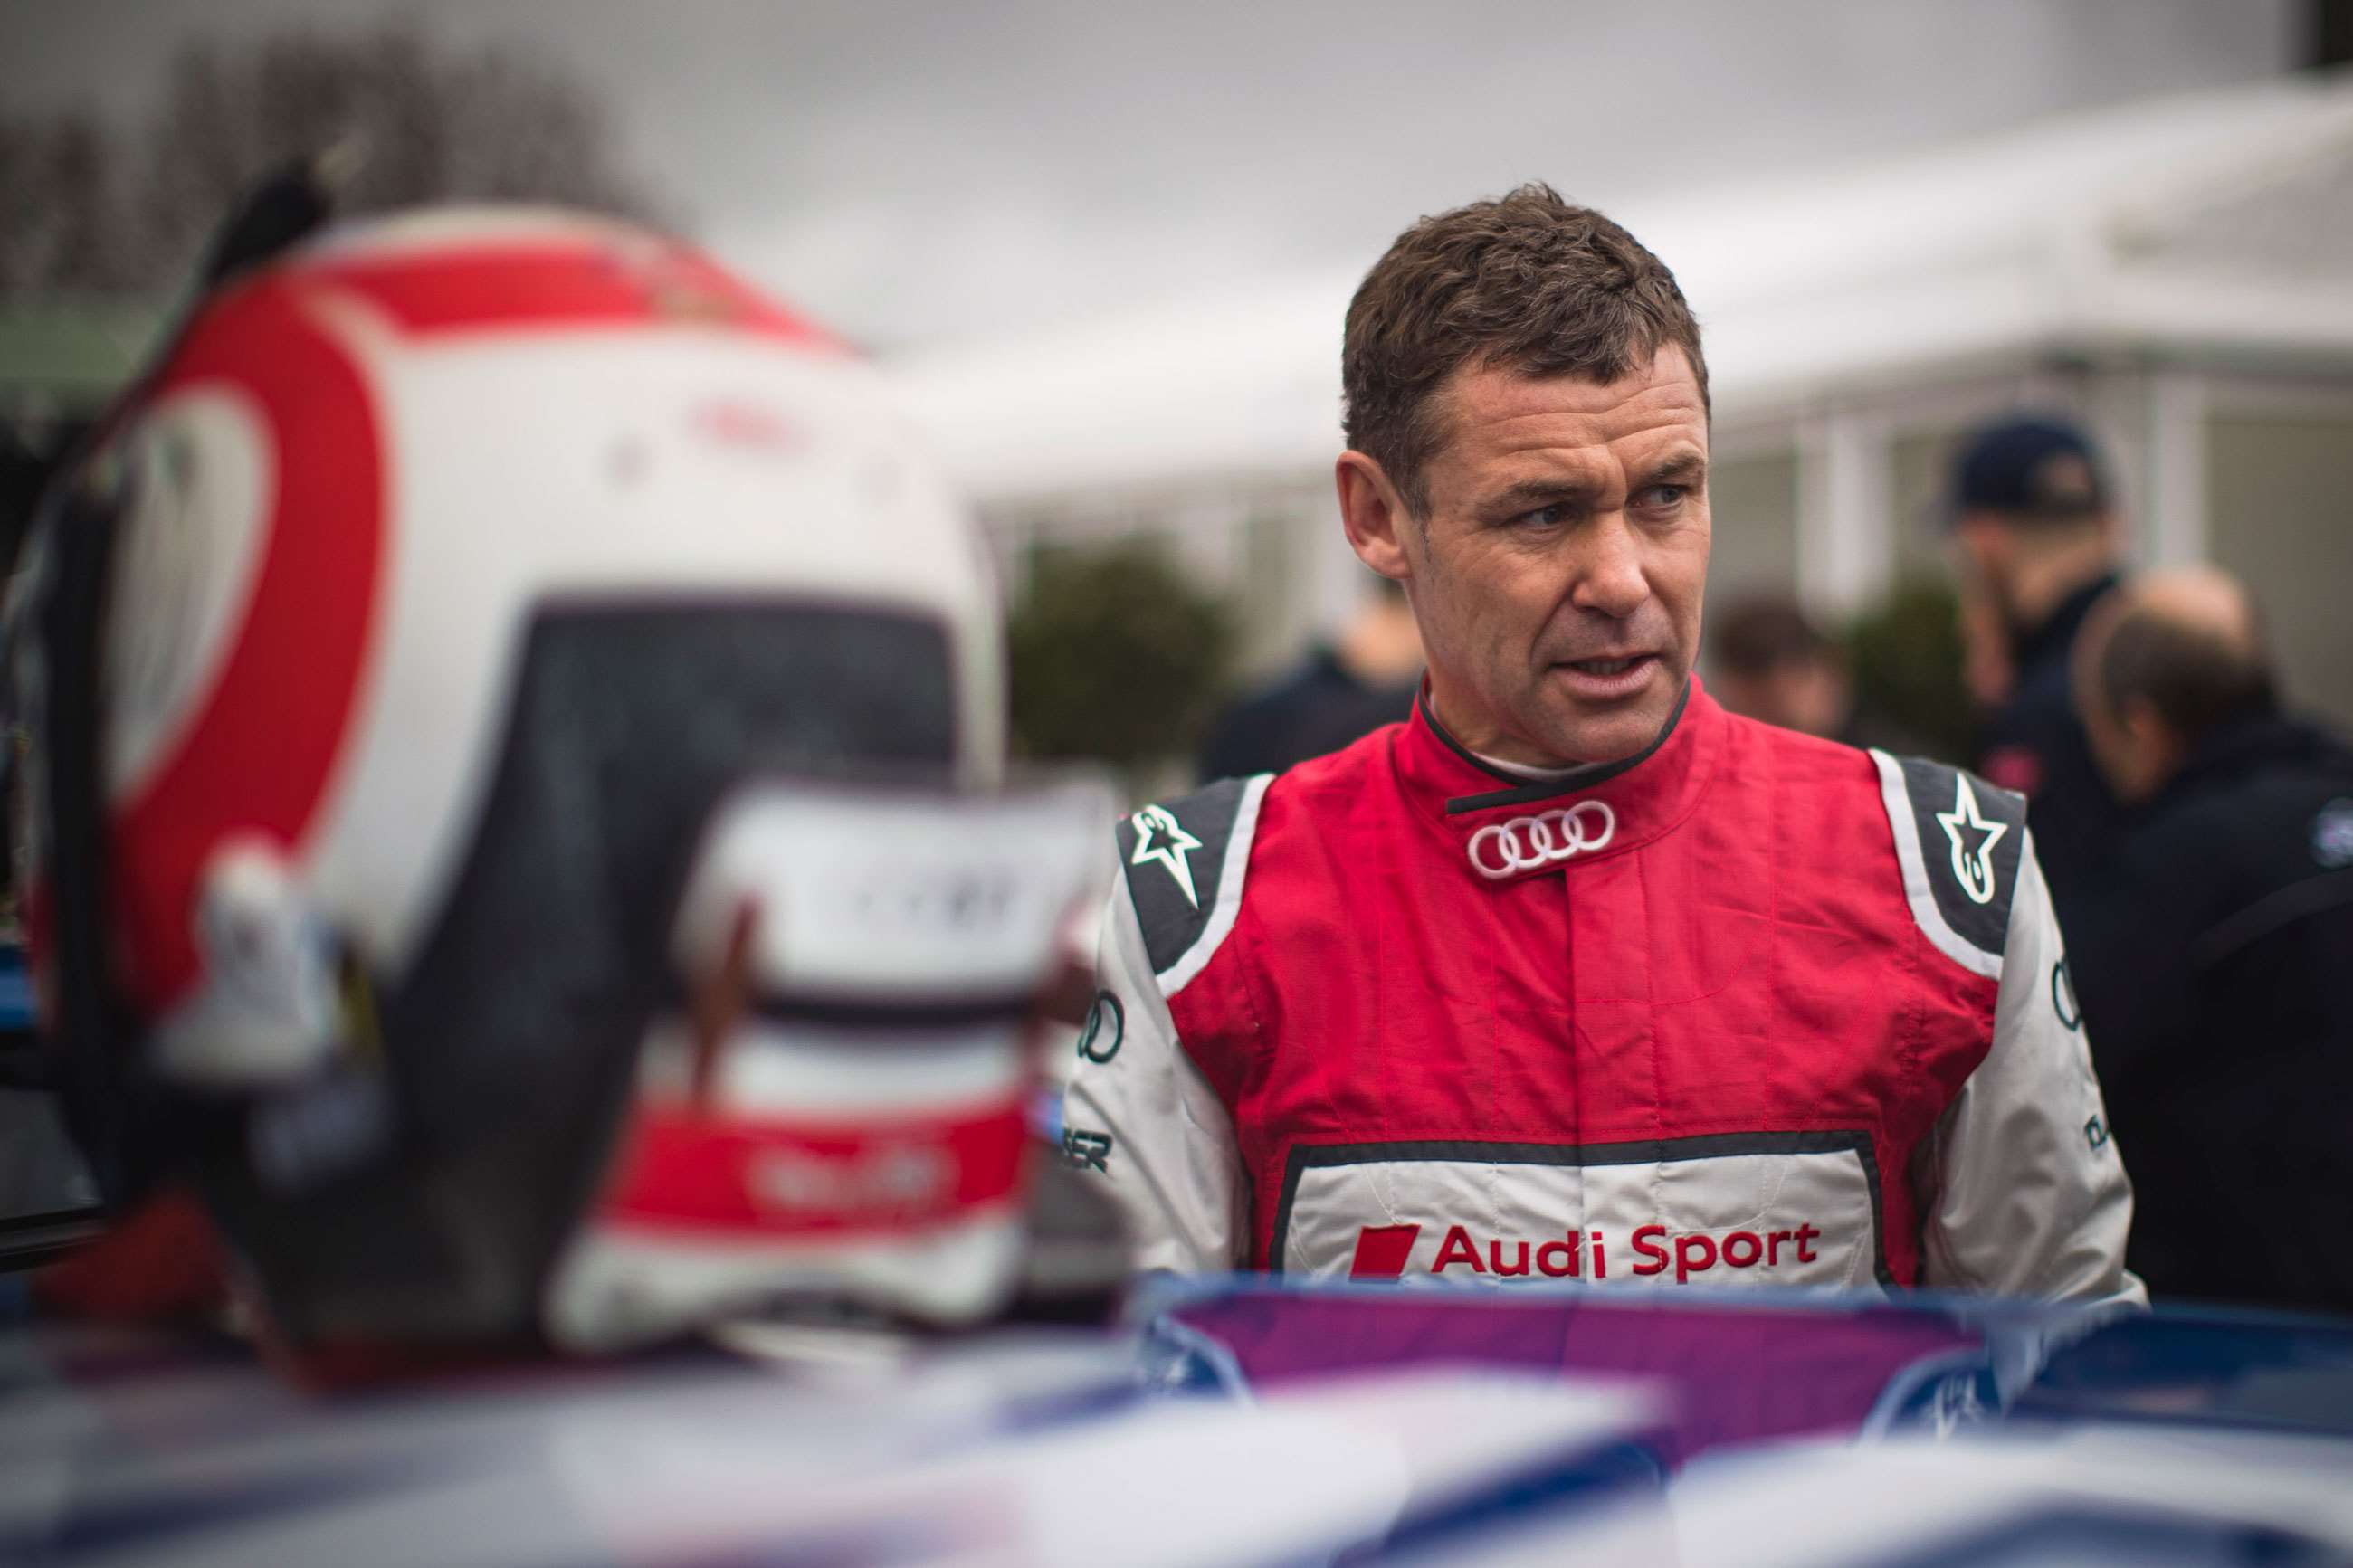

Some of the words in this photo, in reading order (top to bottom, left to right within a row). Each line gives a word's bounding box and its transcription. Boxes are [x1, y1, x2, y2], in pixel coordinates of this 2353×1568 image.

[1064, 1128, 1113, 1173] ER
[1430, 1224, 1606, 1278] Audi
[1631, 1222, 1821, 1285] Sport
